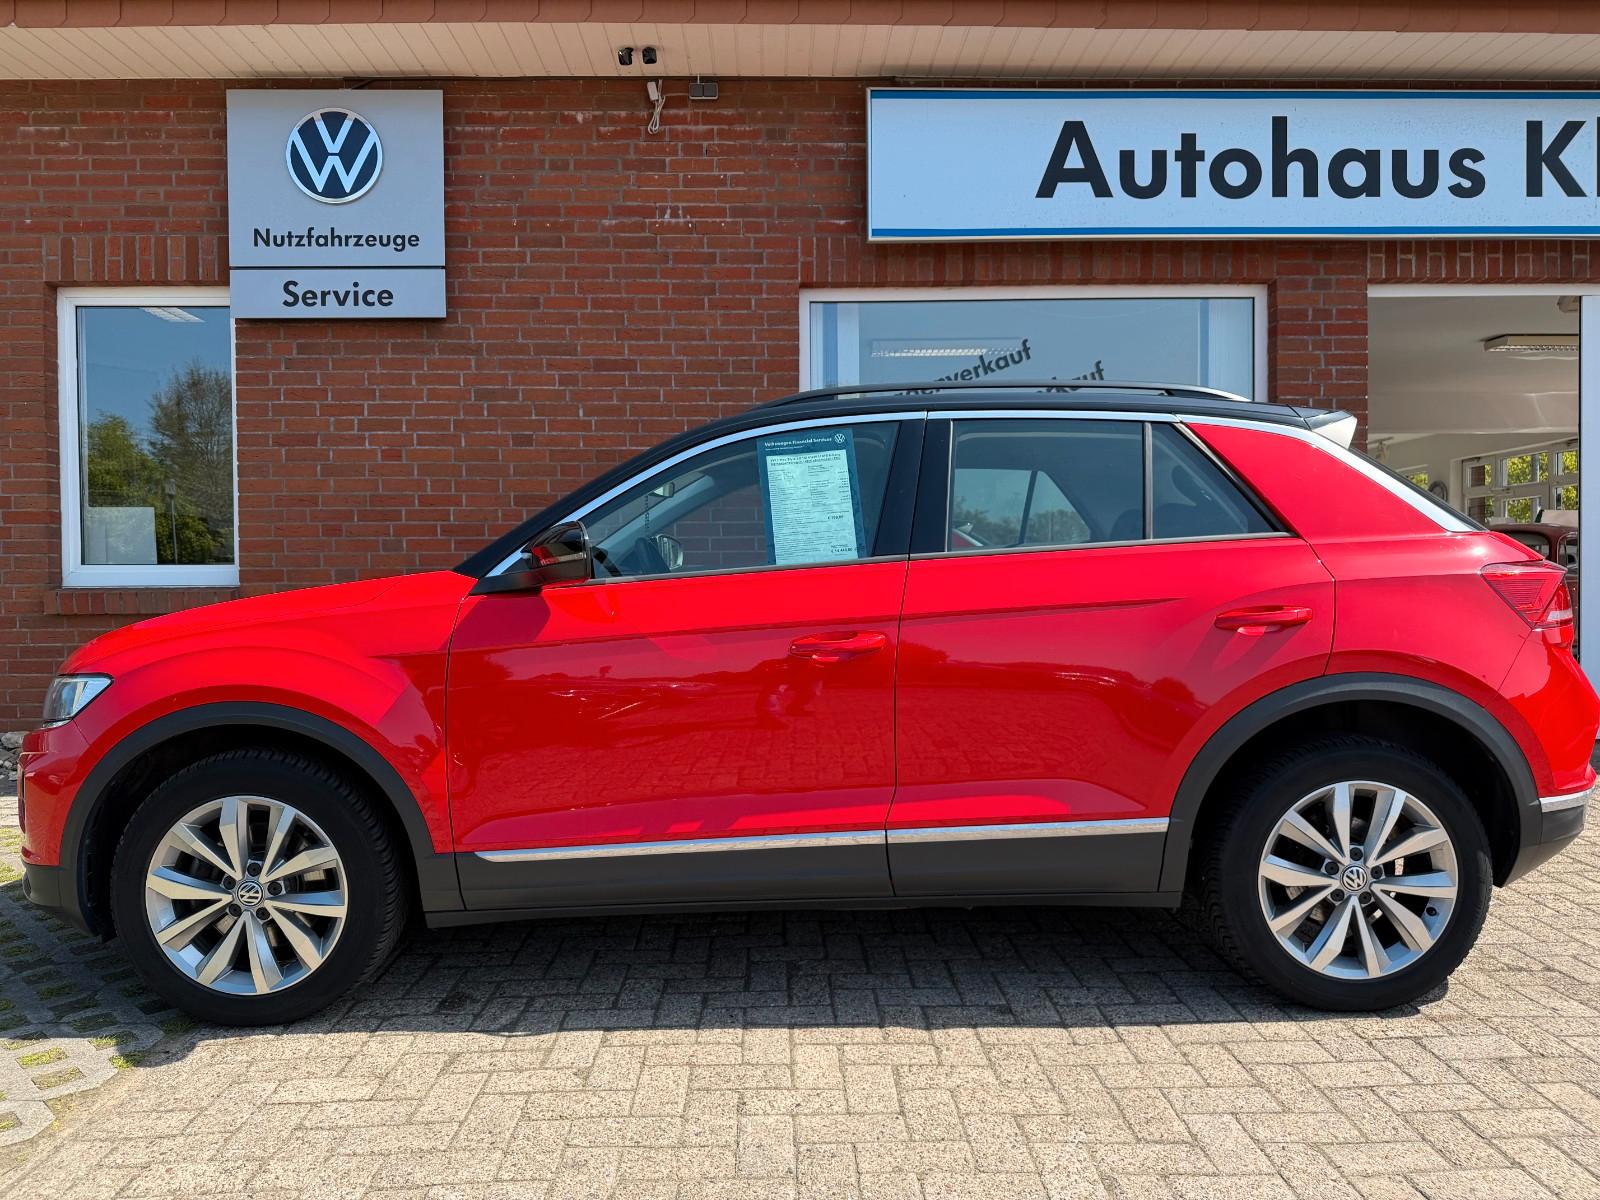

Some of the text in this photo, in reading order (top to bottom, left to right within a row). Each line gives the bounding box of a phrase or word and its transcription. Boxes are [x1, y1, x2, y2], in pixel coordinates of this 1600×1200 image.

[1036, 116, 1600, 199] Autohaus K
[253, 227, 420, 252] Nutzfahrzeuge
[282, 280, 394, 307] Service
